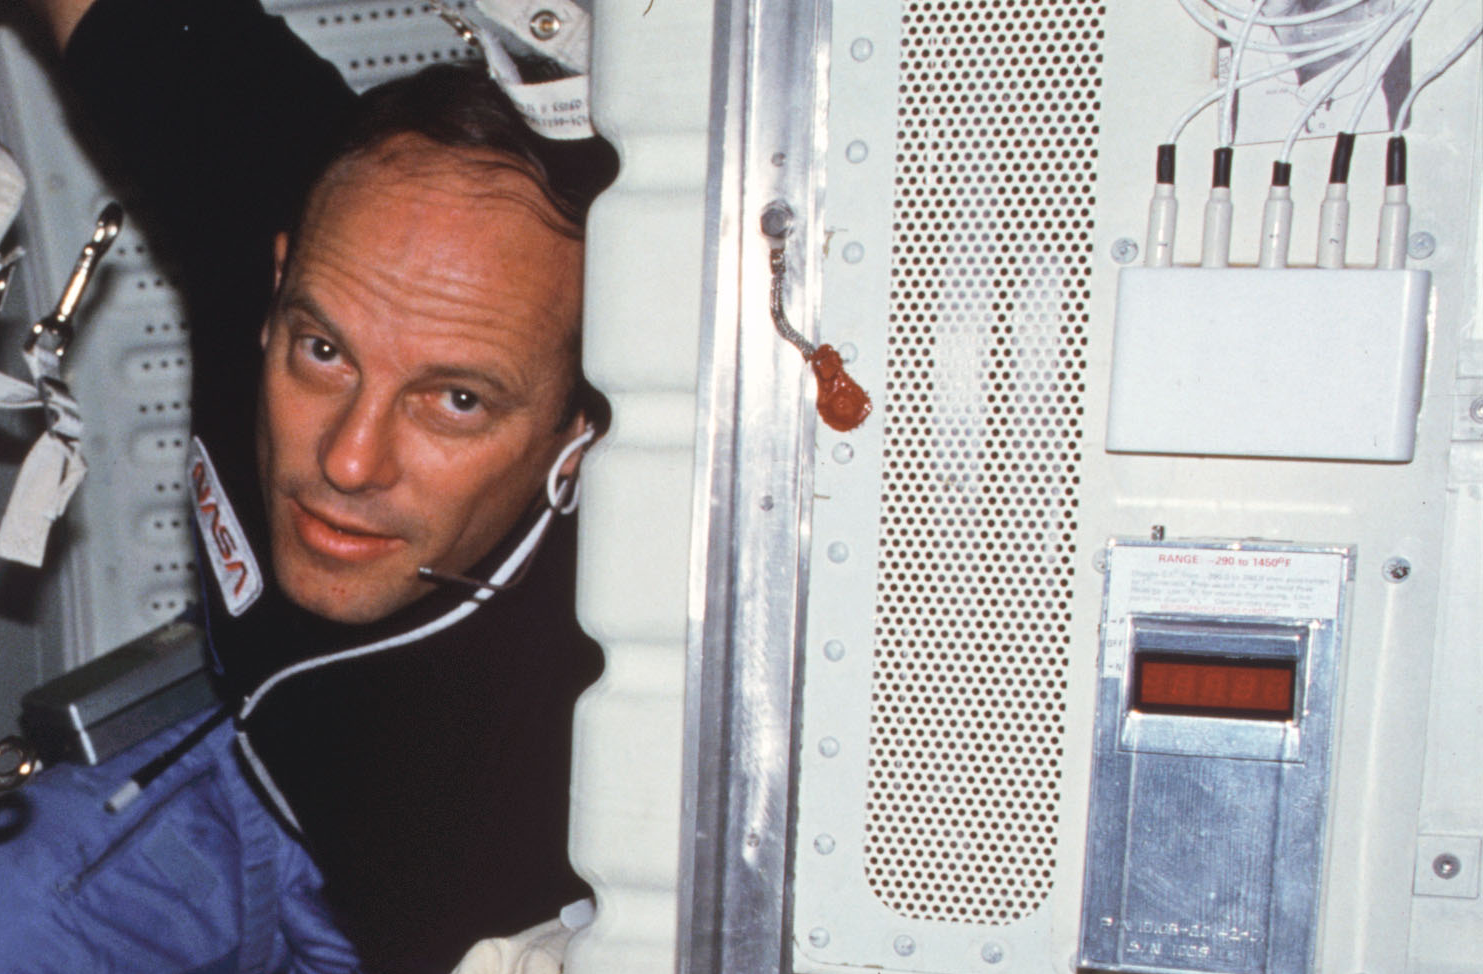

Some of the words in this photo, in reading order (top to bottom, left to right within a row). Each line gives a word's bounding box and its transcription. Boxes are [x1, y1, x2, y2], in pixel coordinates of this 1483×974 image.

[192, 460, 248, 597] NASA
[1158, 554, 1199, 564] RANGE
[1238, 558, 1249, 567] to
